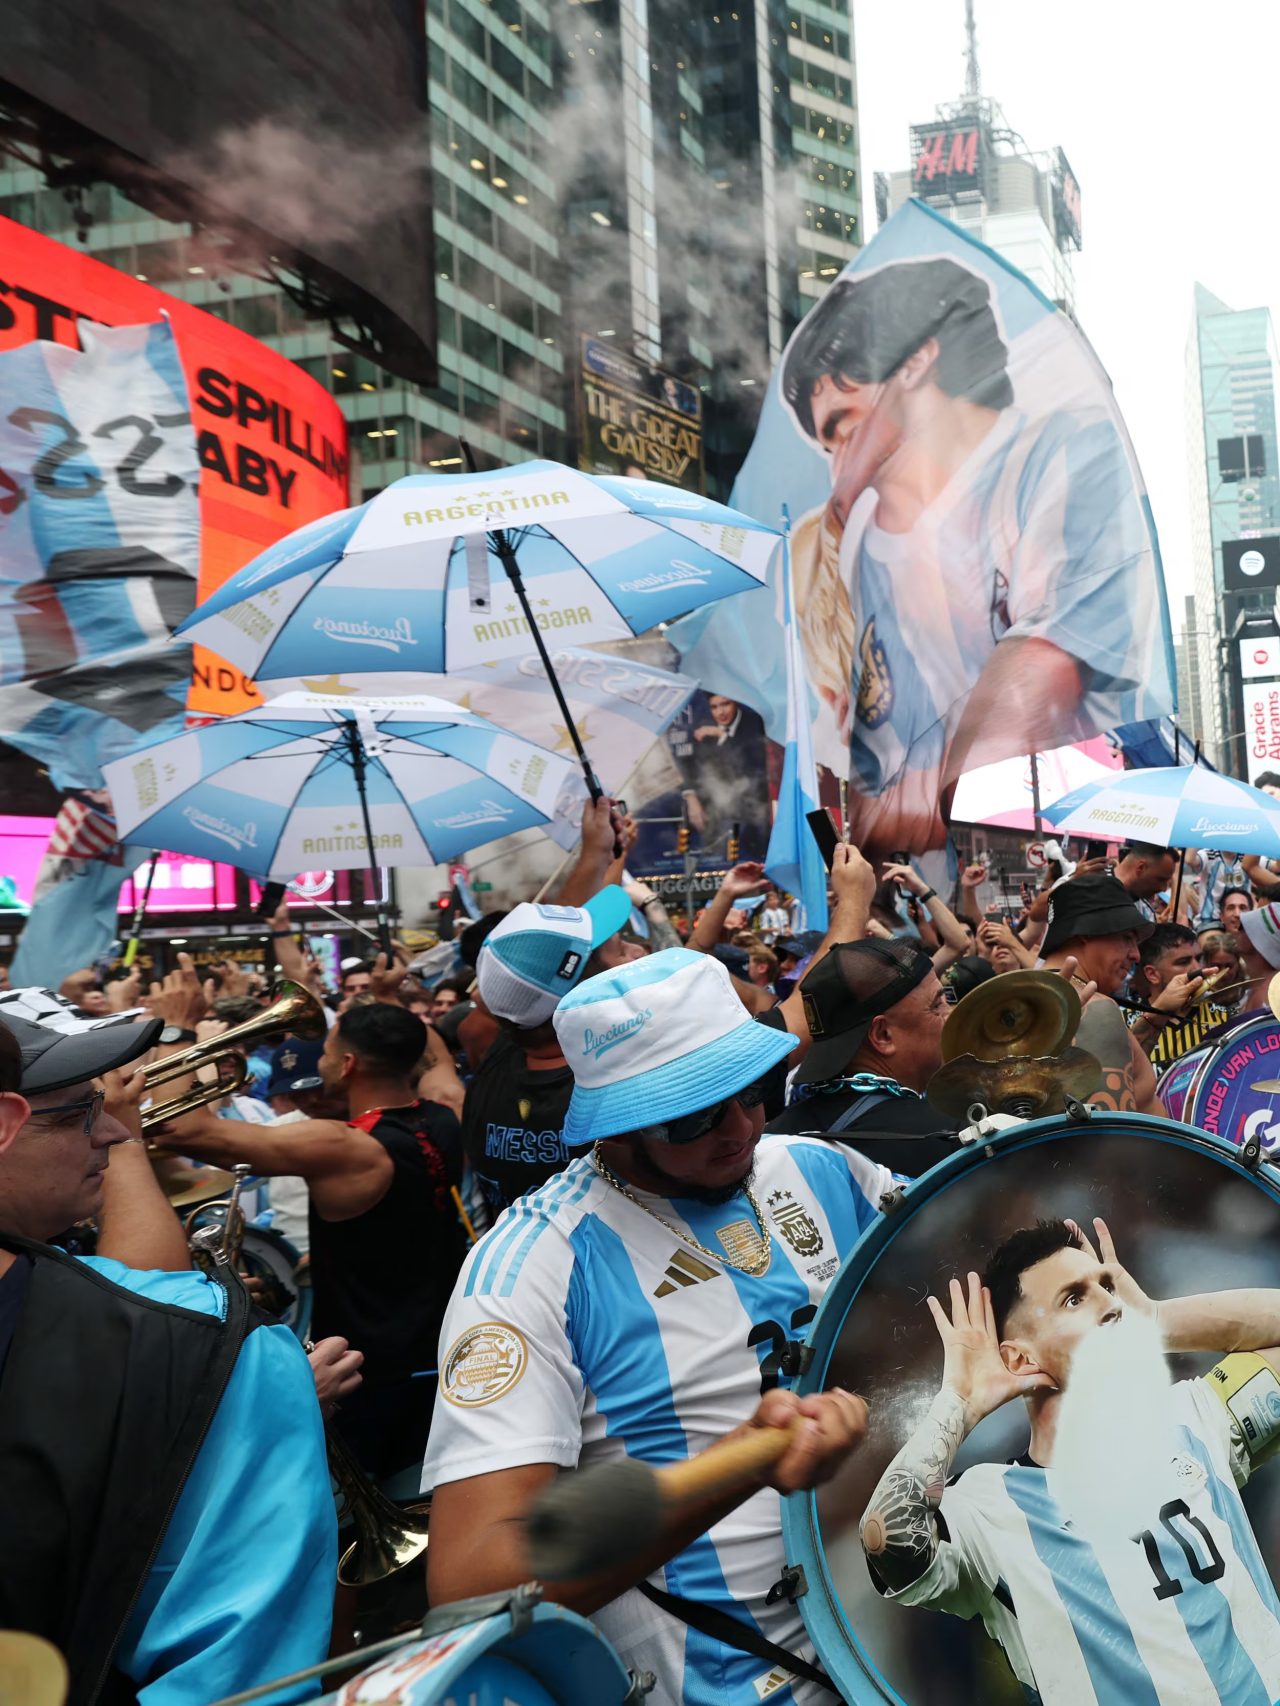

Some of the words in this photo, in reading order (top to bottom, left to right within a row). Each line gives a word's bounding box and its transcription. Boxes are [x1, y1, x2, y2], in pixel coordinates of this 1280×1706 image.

[587, 387, 627, 430] THE
[630, 408, 702, 460] GREAT
[600, 423, 691, 479] GATSBY
[200, 430, 297, 508] ABY
[402, 490, 571, 527] ARGENTINA
[1253, 700, 1266, 760] Gracie
[1087, 808, 1160, 829] ARGENTINA
[652, 875, 726, 894] UGGAGE
[1203, 1082, 1228, 1136] ONDE
[1220, 1047, 1256, 1083] VAN
[485, 1123, 569, 1164] MESSI
[469, 1354, 495, 1364] FINAL
[1129, 1497, 1226, 1601] 10
